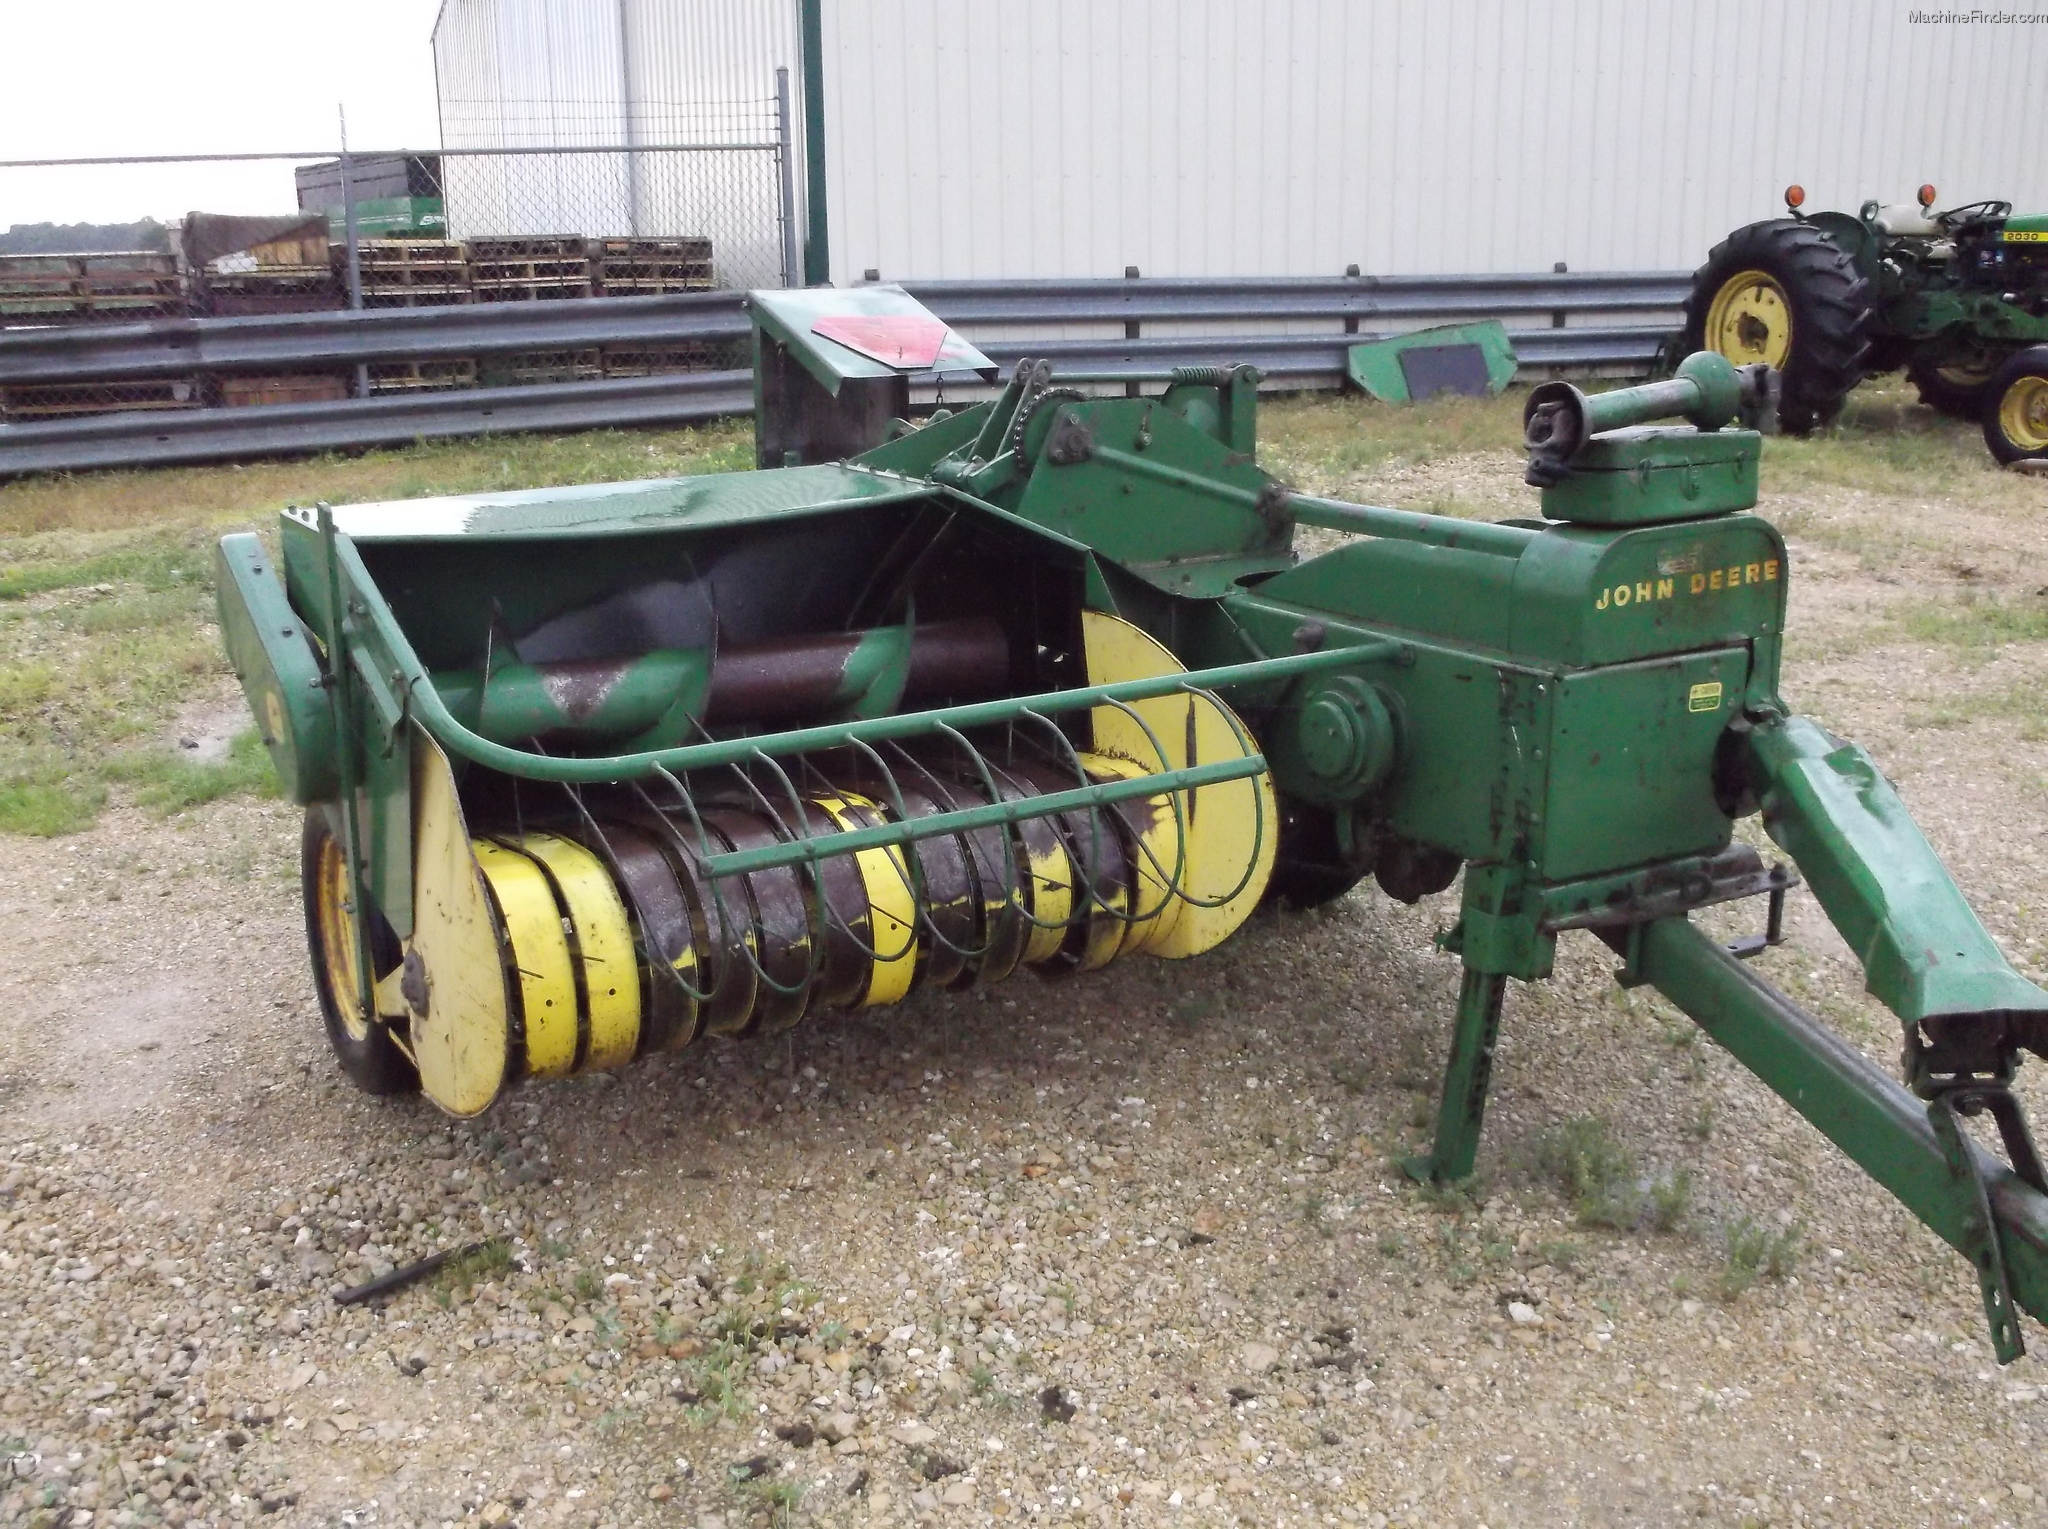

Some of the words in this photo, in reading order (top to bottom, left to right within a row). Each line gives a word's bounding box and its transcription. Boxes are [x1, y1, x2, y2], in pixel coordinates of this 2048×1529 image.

[2007, 232, 2039, 241] 2030
[1596, 578, 1674, 609] JOHN
[1690, 559, 1779, 594] DEERE
